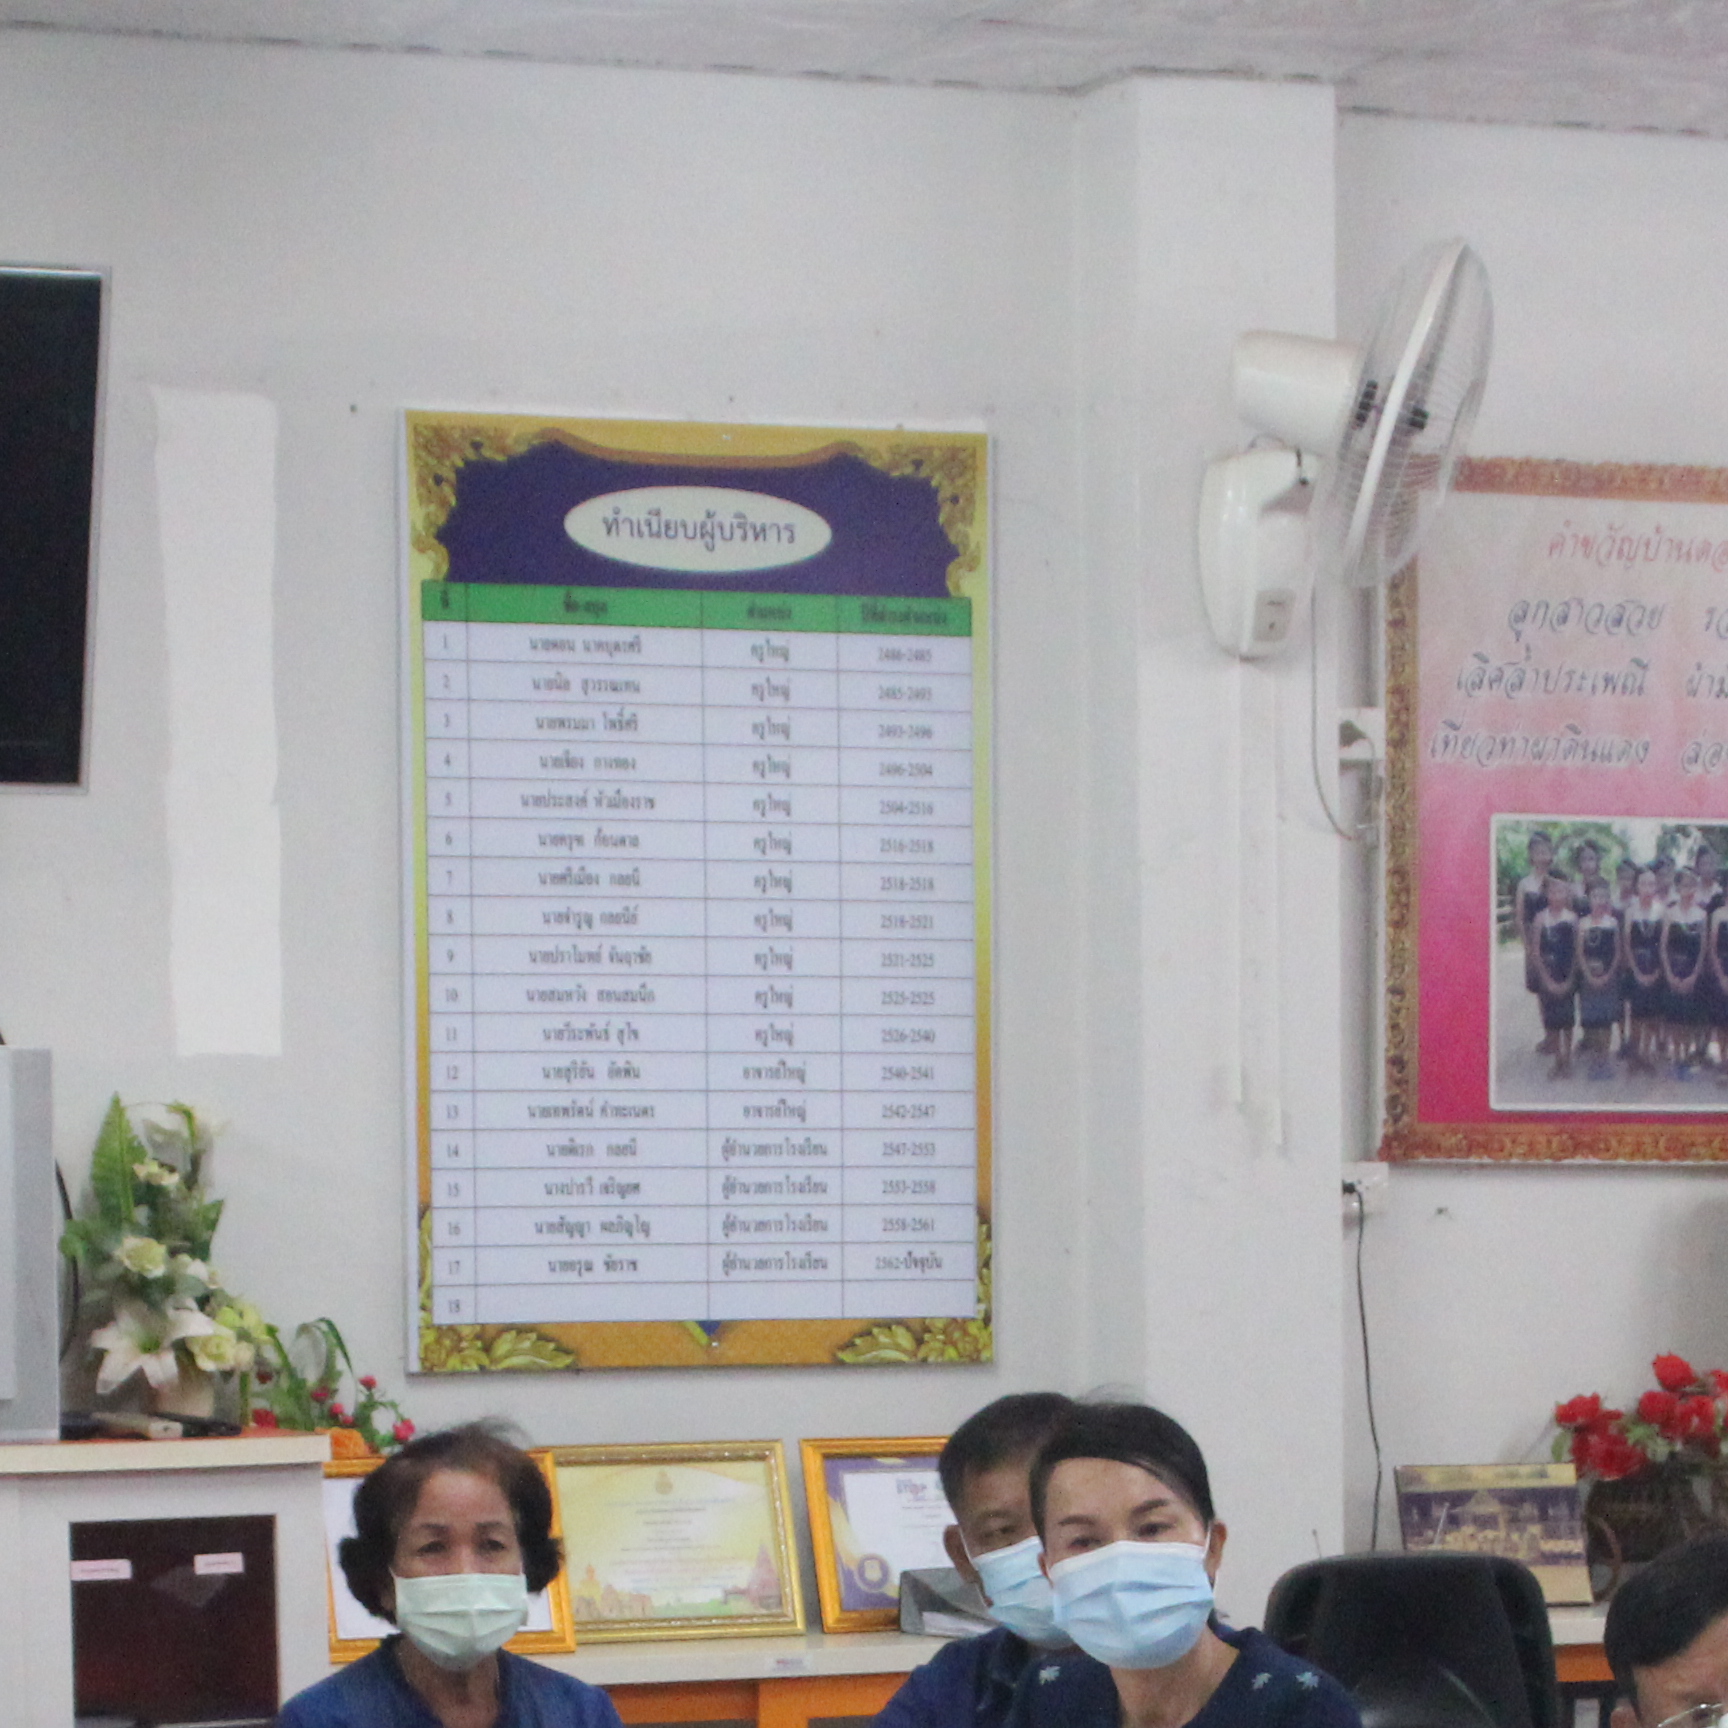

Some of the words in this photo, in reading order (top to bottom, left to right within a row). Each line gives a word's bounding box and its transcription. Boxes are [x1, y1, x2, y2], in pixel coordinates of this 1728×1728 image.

[602, 504, 797, 555] ทำเนียบผู้บริหาร
[1507, 596, 1668, 642] ลูกสาวสวย
